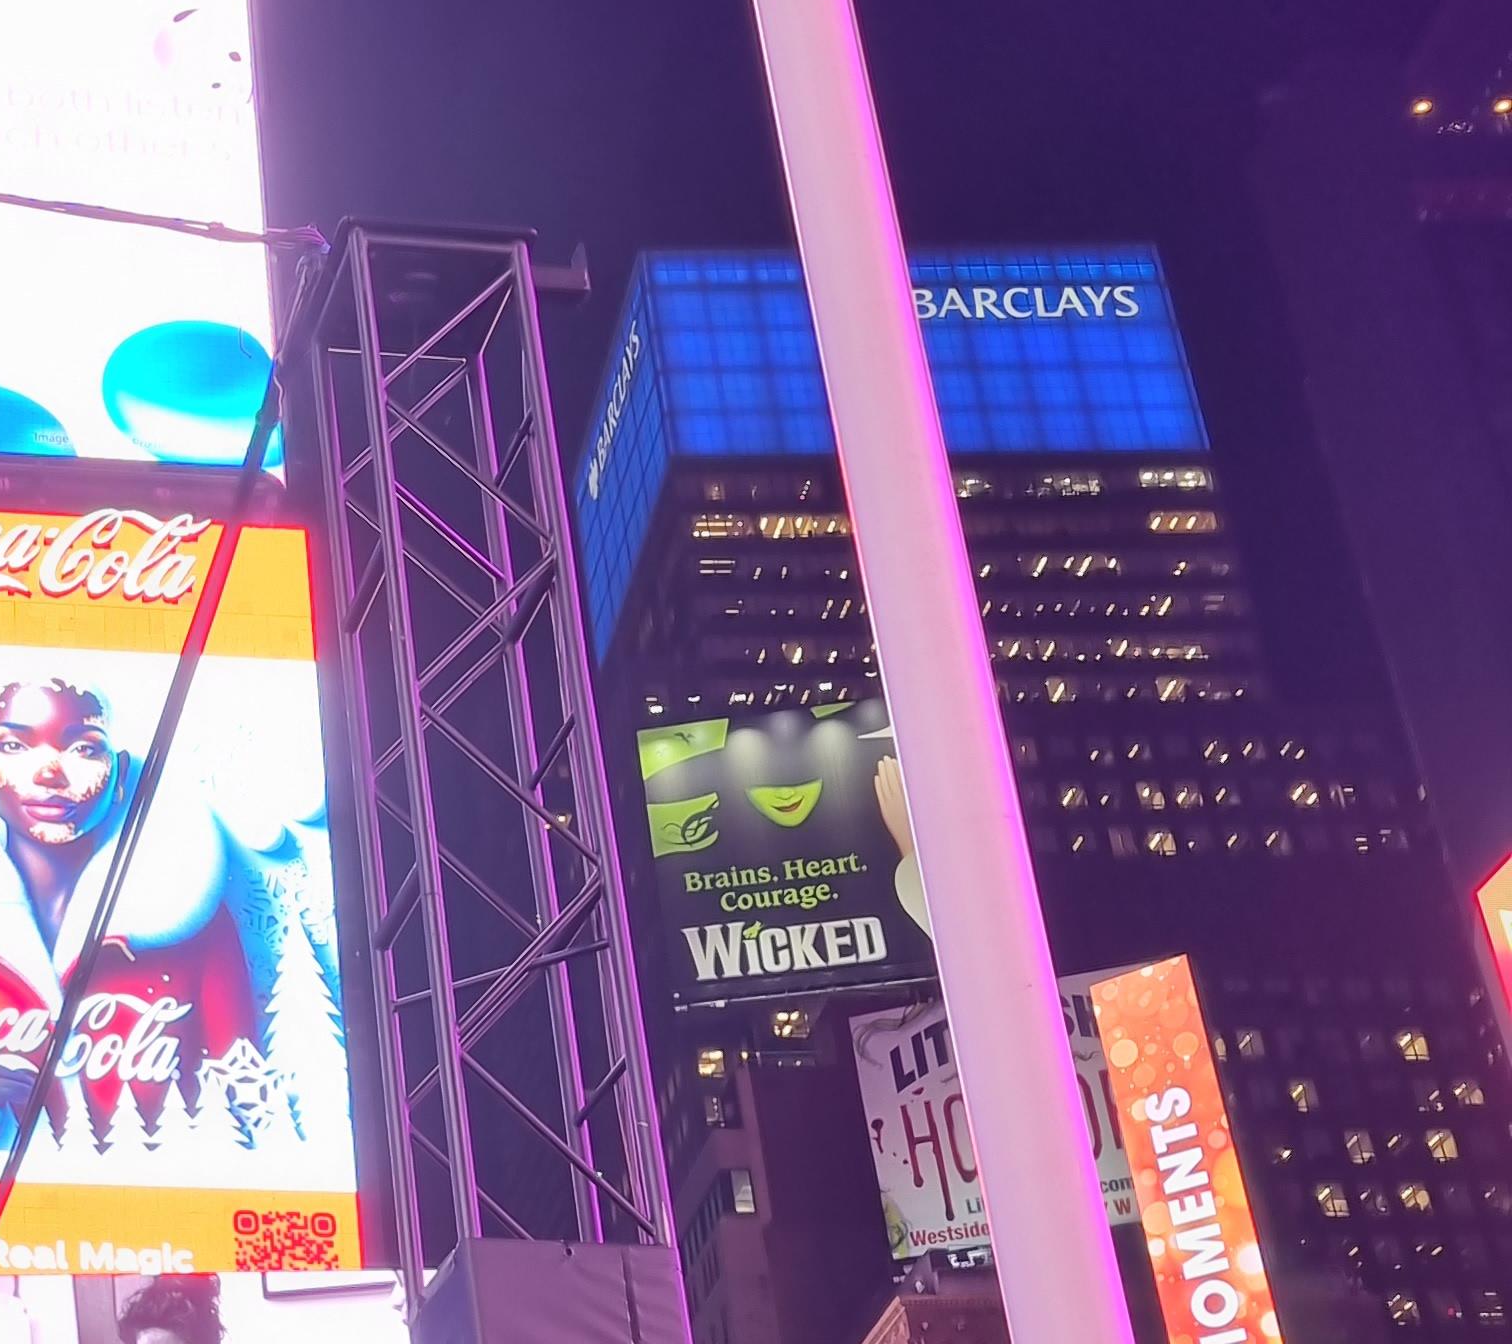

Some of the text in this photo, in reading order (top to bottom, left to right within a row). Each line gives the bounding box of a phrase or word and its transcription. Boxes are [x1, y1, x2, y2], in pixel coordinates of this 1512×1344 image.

[912, 285, 1140, 320] BARCLAYS
[597, 320, 640, 473] BARCLAYS
[684, 852, 867, 892] Brains. Heart.
[720, 883, 839, 912] Courage.
[79, 1242, 195, 1276] Magic
